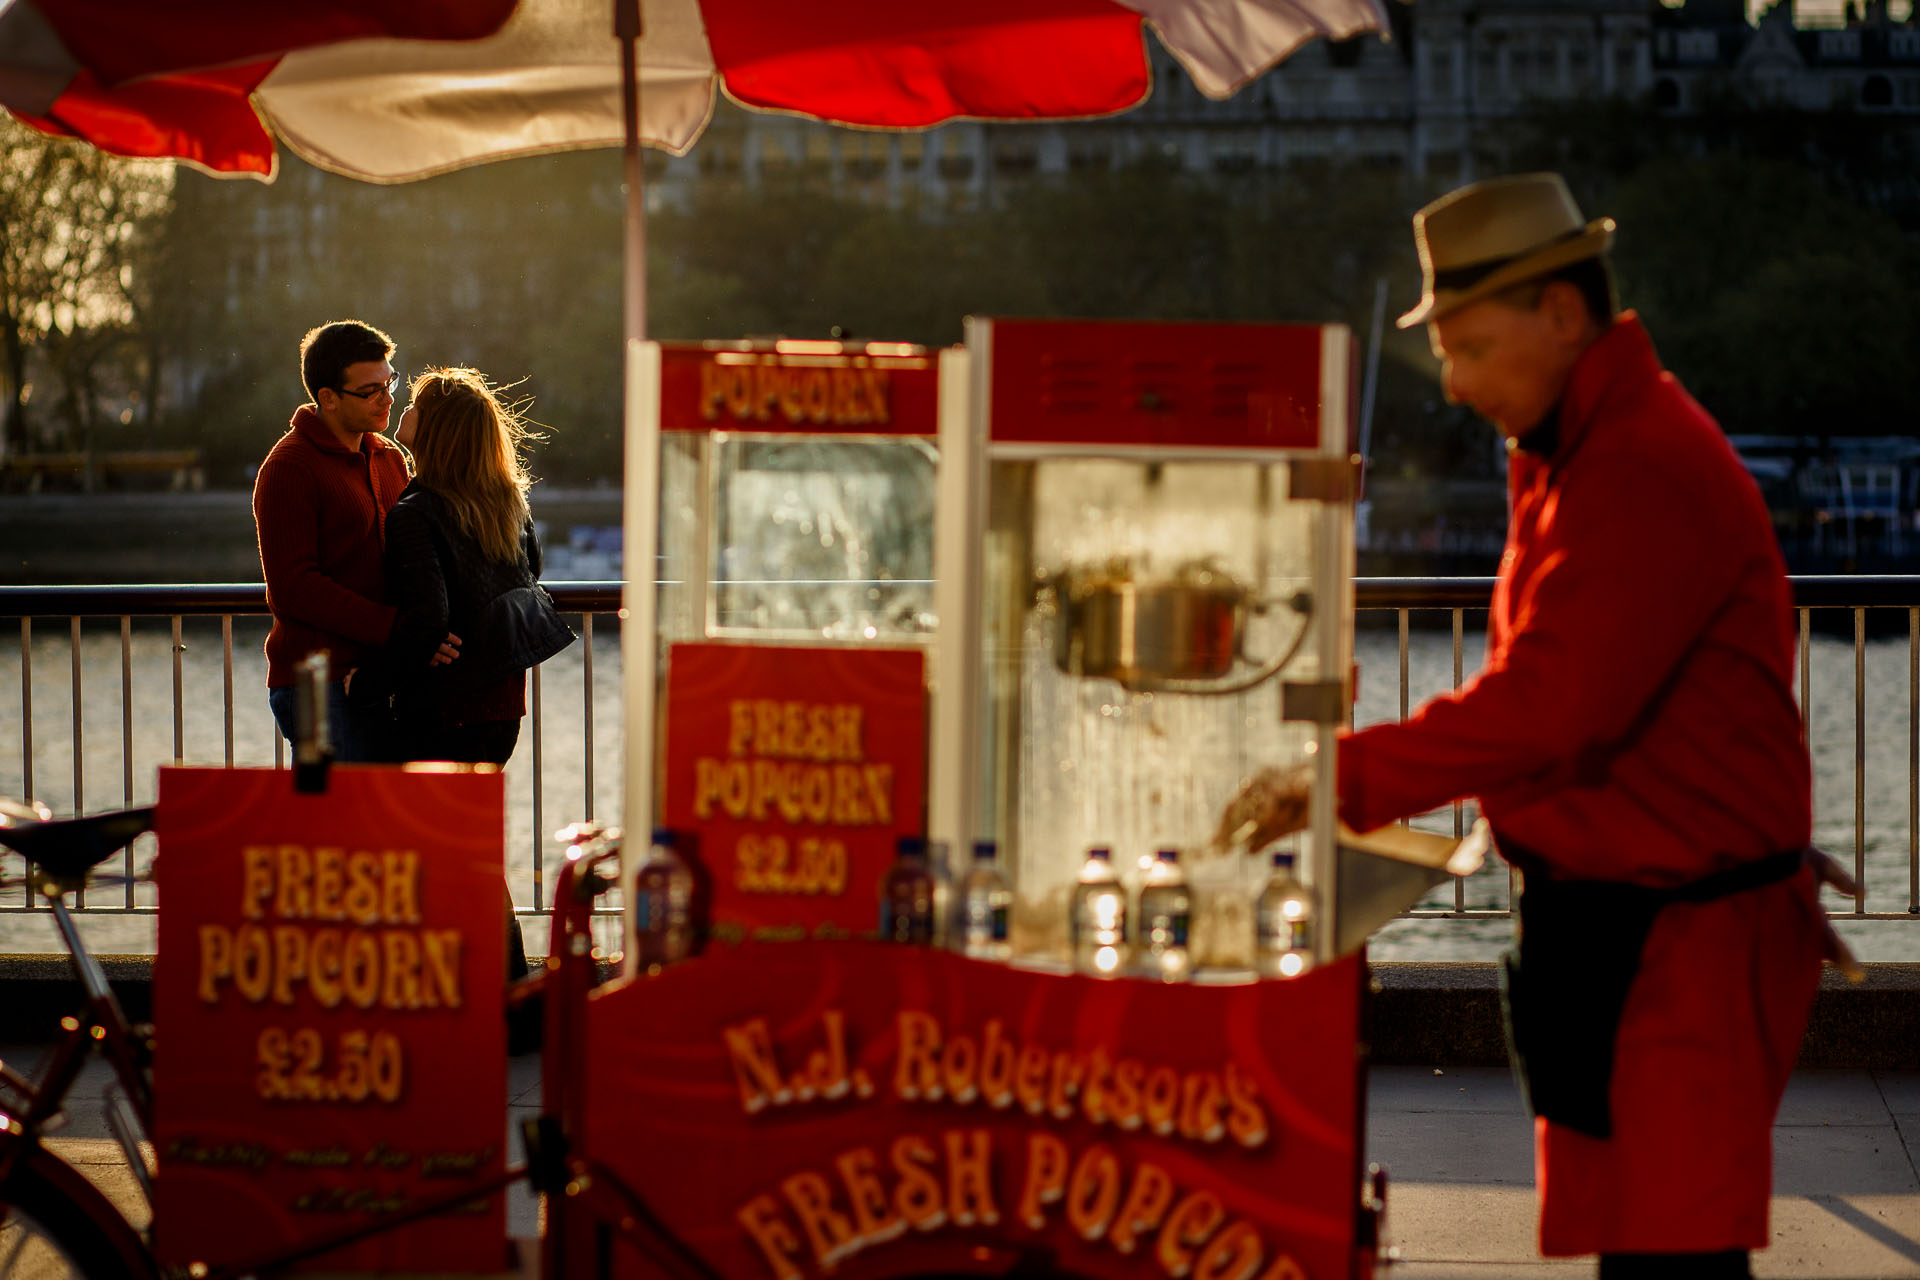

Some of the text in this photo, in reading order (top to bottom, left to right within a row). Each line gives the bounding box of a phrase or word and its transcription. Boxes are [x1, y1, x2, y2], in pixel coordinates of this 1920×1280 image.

[702, 358, 892, 424] POPCORN
[730, 700, 864, 762] FRESH
[693, 756, 894, 825] POPCORN
[242, 844, 423, 926] FRESH
[733, 832, 849, 897] £2.50
[198, 921, 463, 1009] POPCORN
[256, 1027, 404, 1101] £2.50
[892, 1008, 1271, 1150] Robertson's
[735, 1128, 1001, 1280] FRESH
